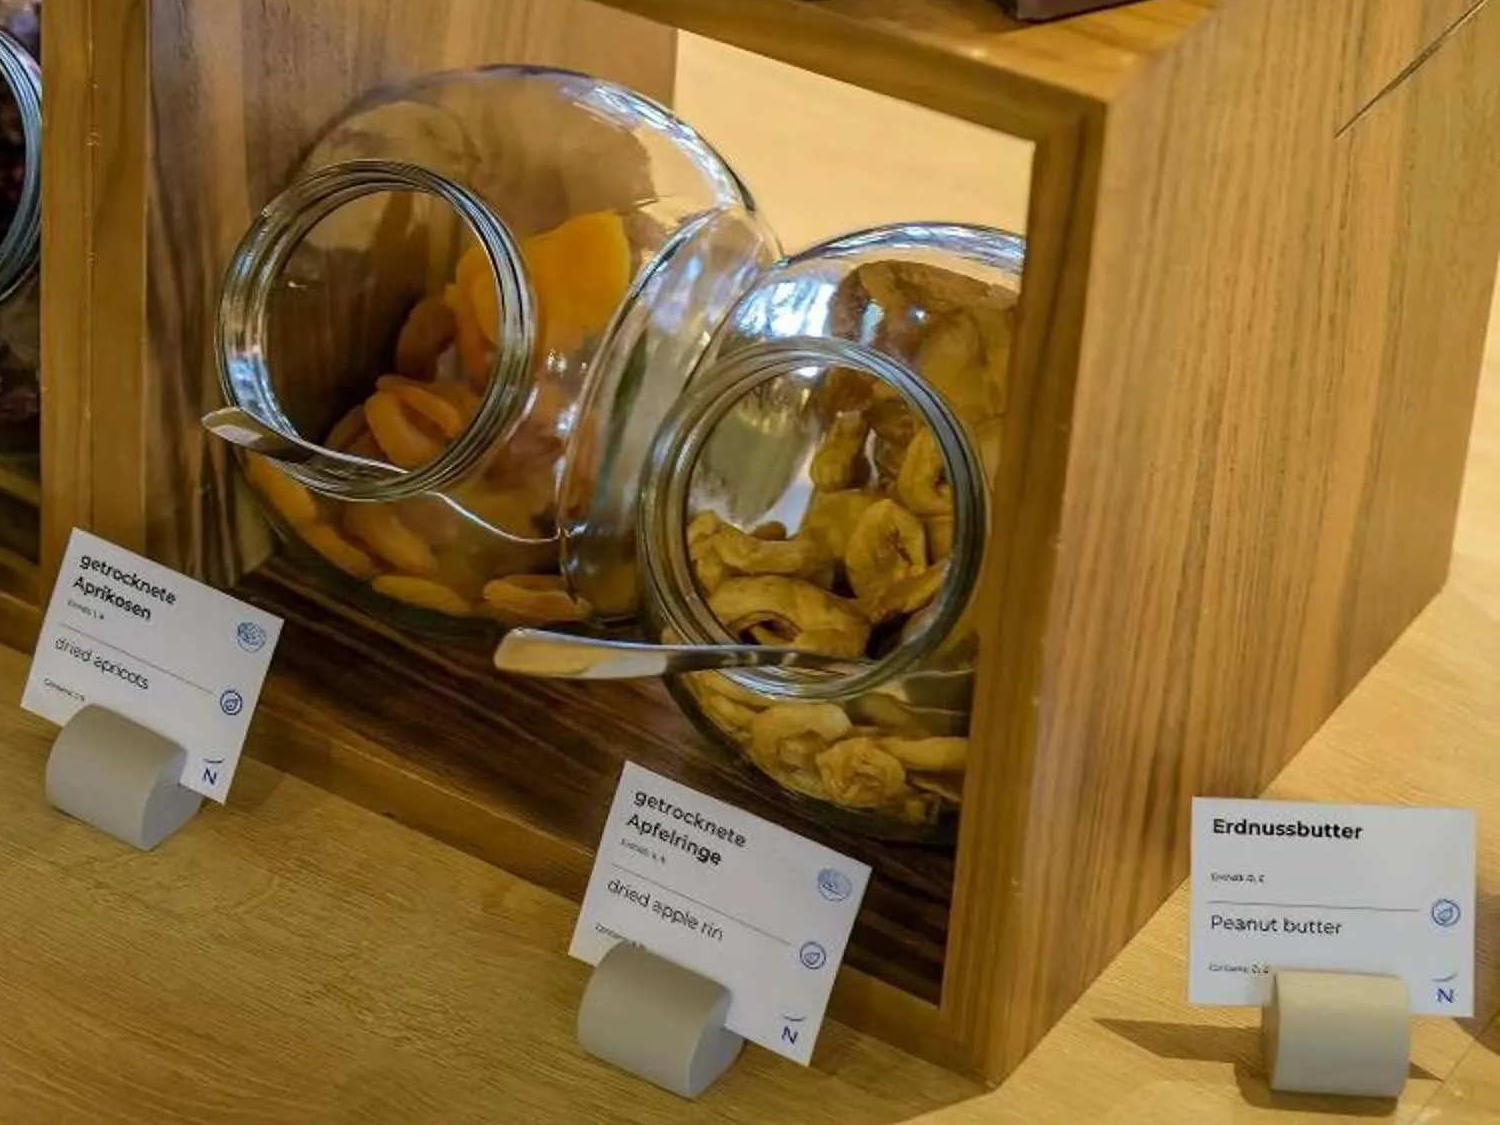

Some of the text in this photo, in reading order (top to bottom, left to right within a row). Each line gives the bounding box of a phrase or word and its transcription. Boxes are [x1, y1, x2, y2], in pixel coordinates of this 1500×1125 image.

[72, 576, 152, 621] Aprikosen
[80, 553, 177, 606] getrocknete
[54, 636, 93, 663] dried
[93, 655, 150, 691] apricots
[626, 813, 723, 867] Apfelringe
[634, 789, 748, 849] getrocknete
[1212, 818, 1364, 840] Erdnussbutter
[606, 877, 650, 908] dried
[651, 898, 699, 931] apple
[1210, 914, 1343, 936] Peanut butter
